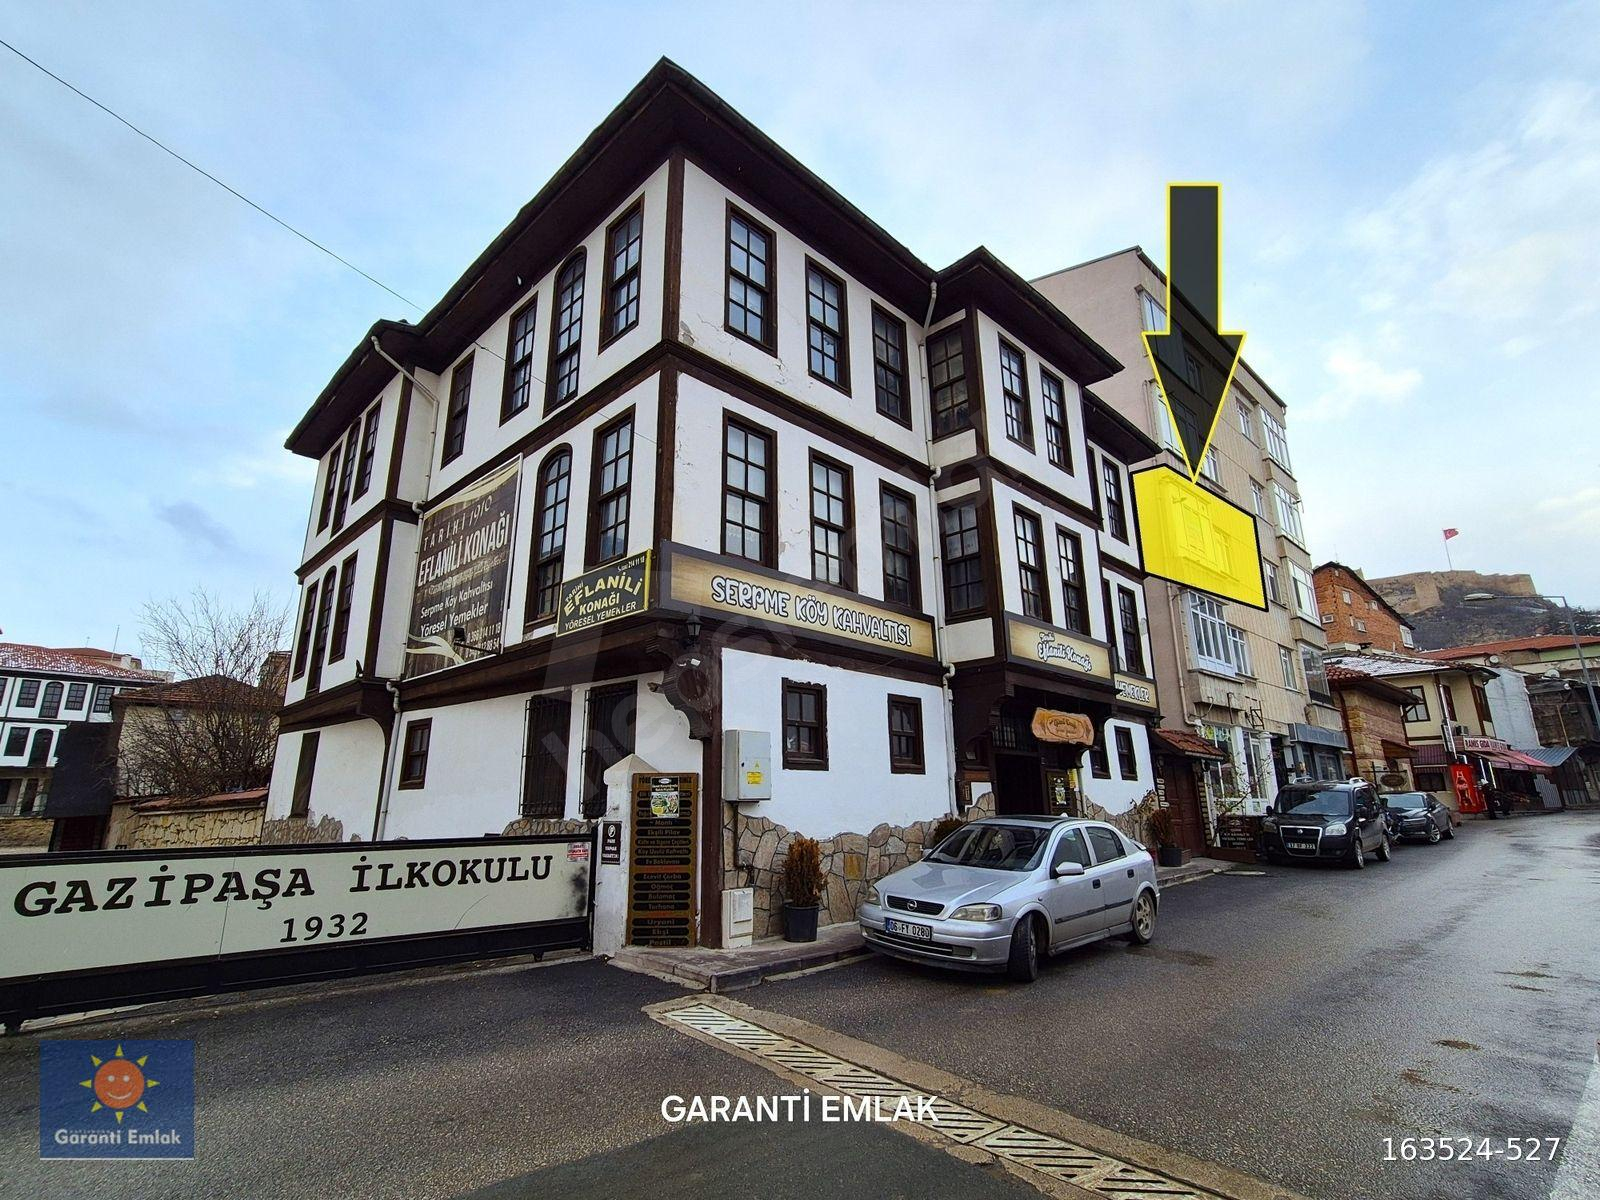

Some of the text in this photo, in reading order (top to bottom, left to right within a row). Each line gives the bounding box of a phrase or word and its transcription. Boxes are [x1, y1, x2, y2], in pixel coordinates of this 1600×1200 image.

[417, 535, 463, 587] EFLANİLİ
[463, 510, 510, 565] KONAĞI
[420, 602, 444, 619] Serpme
[564, 572, 643, 616] EFLANİLİ
[579, 590, 620, 616] KONAĞI
[711, 575, 912, 646] SERPME KÖY KAHVALTISI
[420, 601, 489, 638] Yöresel Yemekler
[565, 601, 637, 631] YÖRESEL YEMEKLER
[14, 855, 554, 918] GAZİPAŞA İLKOKULU
[280, 911, 369, 943] 1932
[901, 923, 910, 934] FY
